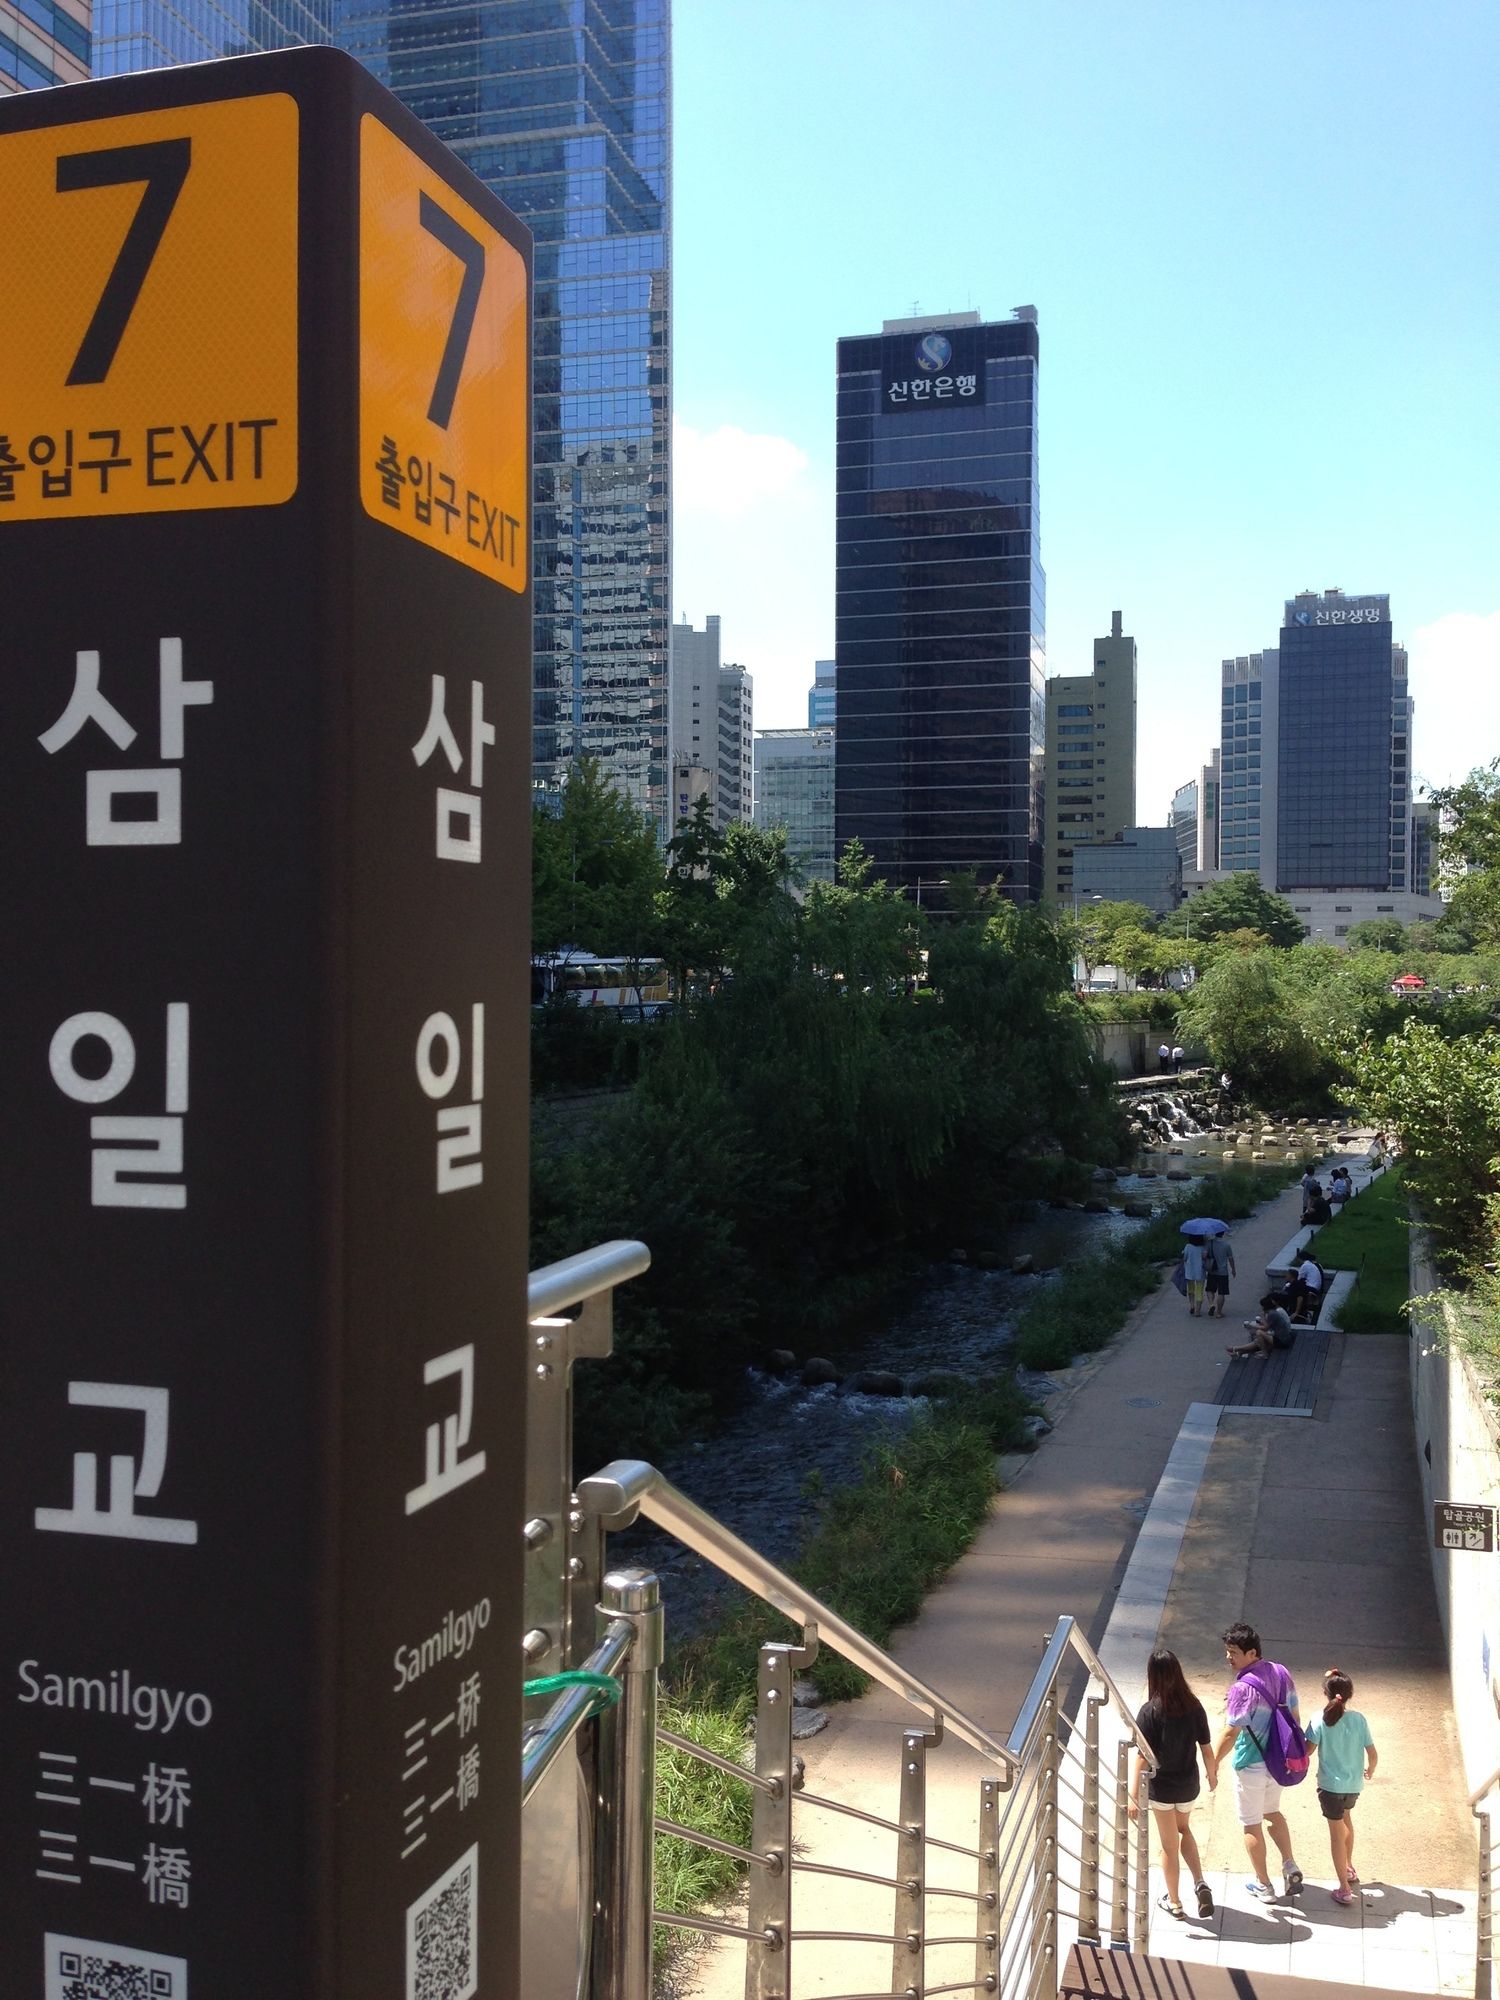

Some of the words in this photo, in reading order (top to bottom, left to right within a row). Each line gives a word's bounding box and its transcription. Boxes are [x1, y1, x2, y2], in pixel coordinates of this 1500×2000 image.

[56, 137, 192, 387] 7
[419, 188, 486, 432] 7
[888, 374, 977, 402] 신한은행
[147, 418, 278, 487] EXIT
[375, 434, 462, 536] 출입구
[466, 489, 521, 568] EXIT
[1315, 608, 1380, 626] 신한생명
[34, 636, 214, 1545] 삼일교
[405, 673, 496, 1516] 삼일교
[1443, 1509, 1485, 1524] 탑골공원
[393, 1597, 491, 1692] Samilgyo
[18, 1659, 213, 1734] Samilgyo
[402, 1671, 481, 1781] 三一桥
[35, 1751, 191, 1828] 三一桥
[401, 1743, 480, 1860] 三一橋
[35, 1829, 191, 1909] 三一橋
